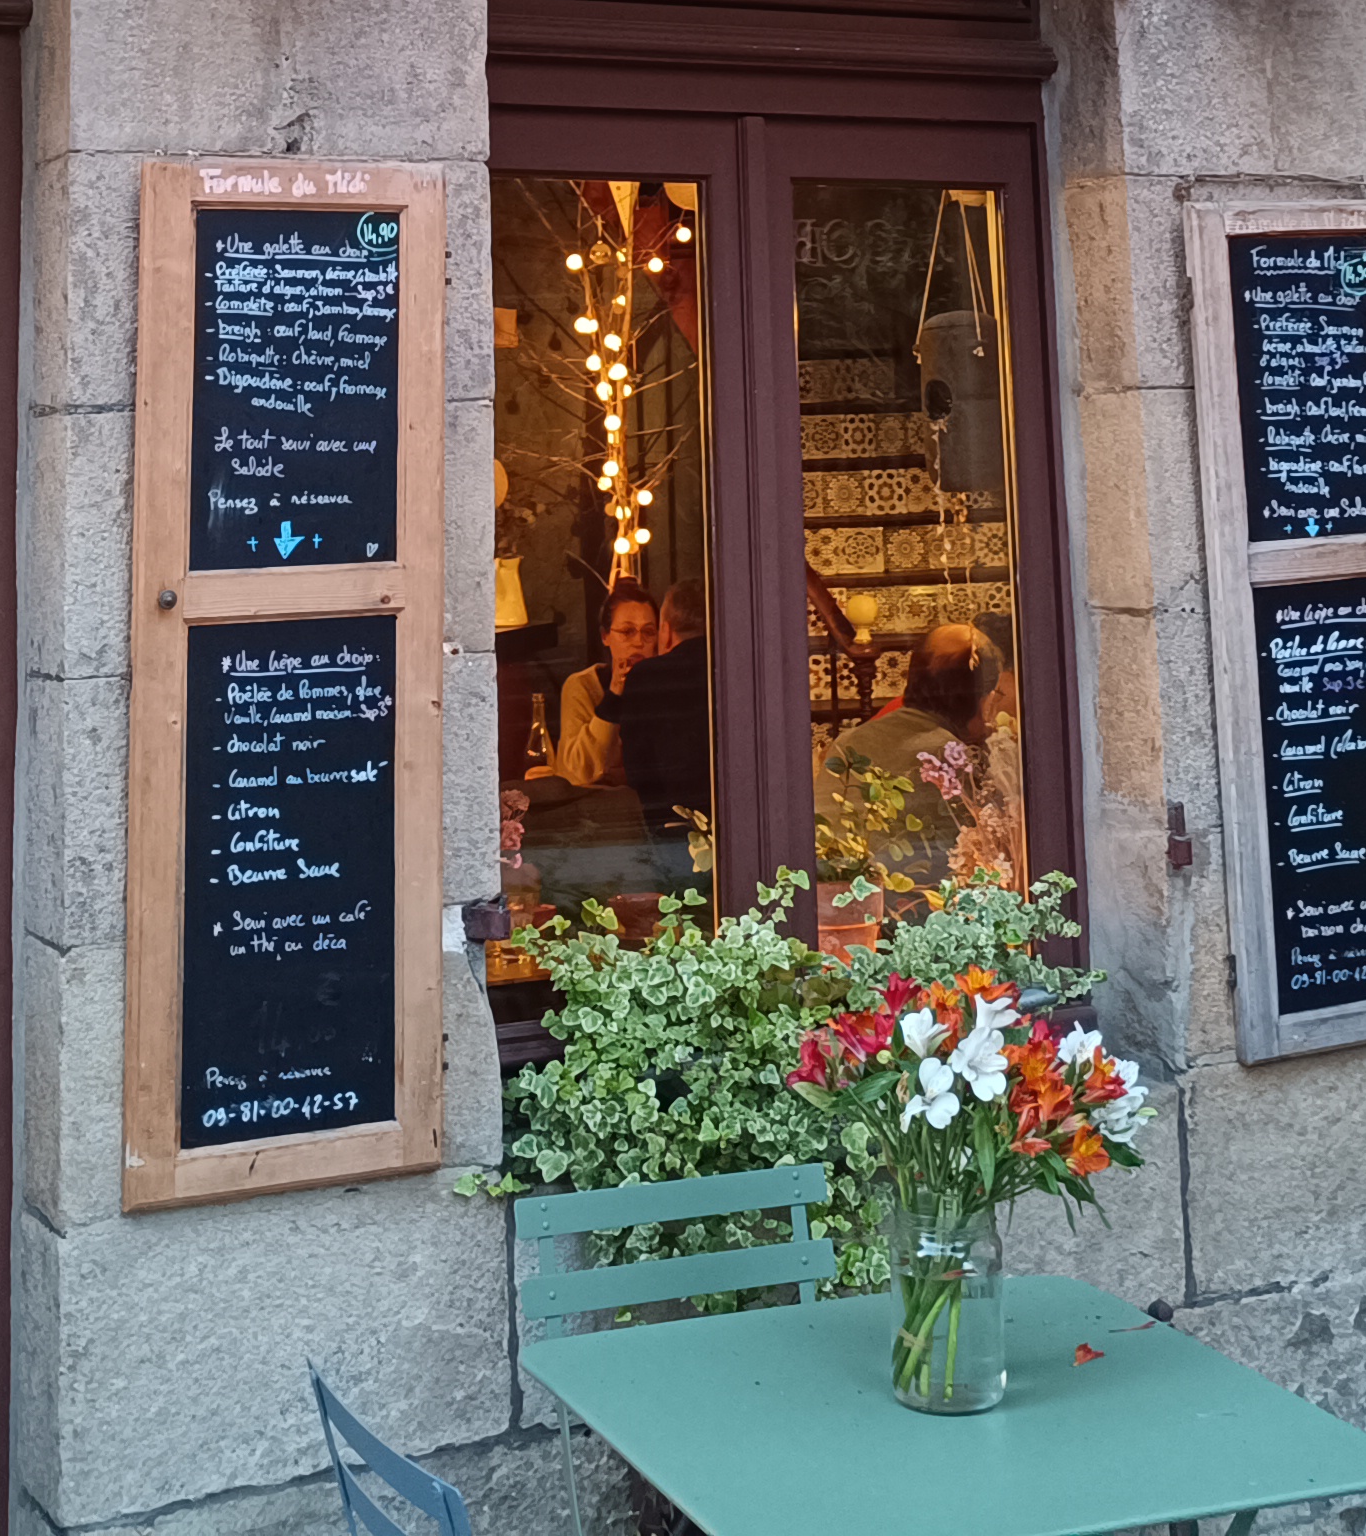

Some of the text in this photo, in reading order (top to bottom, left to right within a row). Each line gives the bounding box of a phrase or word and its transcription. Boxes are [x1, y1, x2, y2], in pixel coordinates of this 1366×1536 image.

[199, 167, 371, 198] Formule du Midi
[1250, 245, 1304, 269] Formule
[214, 426, 234, 452] Le
[237, 428, 277, 450] tout
[316, 438, 348, 452] avec
[269, 492, 281, 506] à
[291, 491, 353, 505] réserver
[277, 682, 295, 701] de
[292, 736, 326, 751] noir
[227, 800, 280, 821] Citron
[1287, 802, 1344, 827] Confiture
[229, 828, 300, 854] Confiture
[227, 864, 288, 885] Beurre
[272, 914, 306, 929] avec
[338, 899, 371, 923] café
[312, 932, 347, 951] déca
